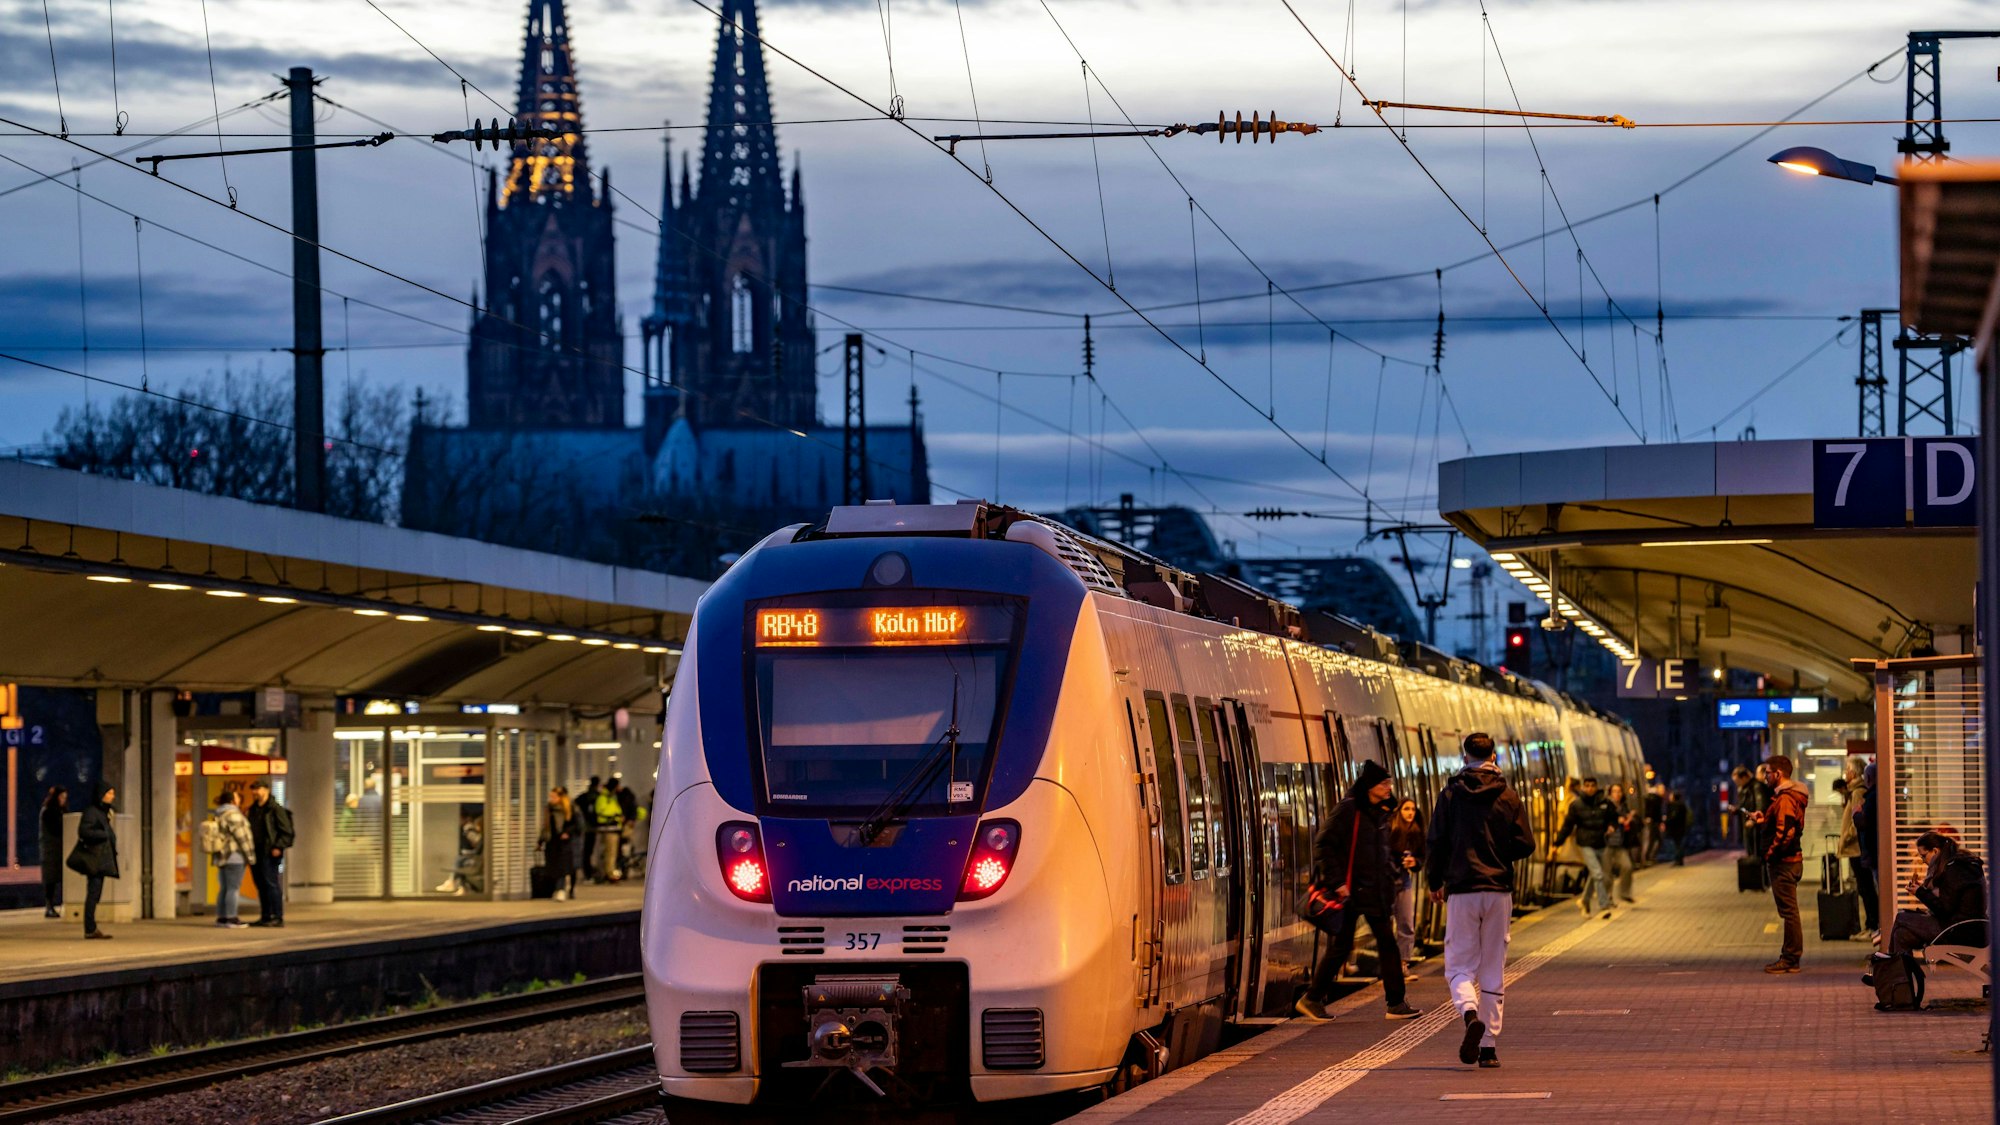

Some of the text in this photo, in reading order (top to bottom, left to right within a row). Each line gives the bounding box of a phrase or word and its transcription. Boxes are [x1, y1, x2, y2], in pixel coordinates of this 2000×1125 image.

[1826, 442, 1975, 506] 7 D
[763, 612, 957, 636] RB48 Köln Hbf
[1621, 659, 1685, 690] 7 E
[31, 725, 43, 744] 2
[788, 874, 943, 894] national express
[845, 933, 881, 950] 357
